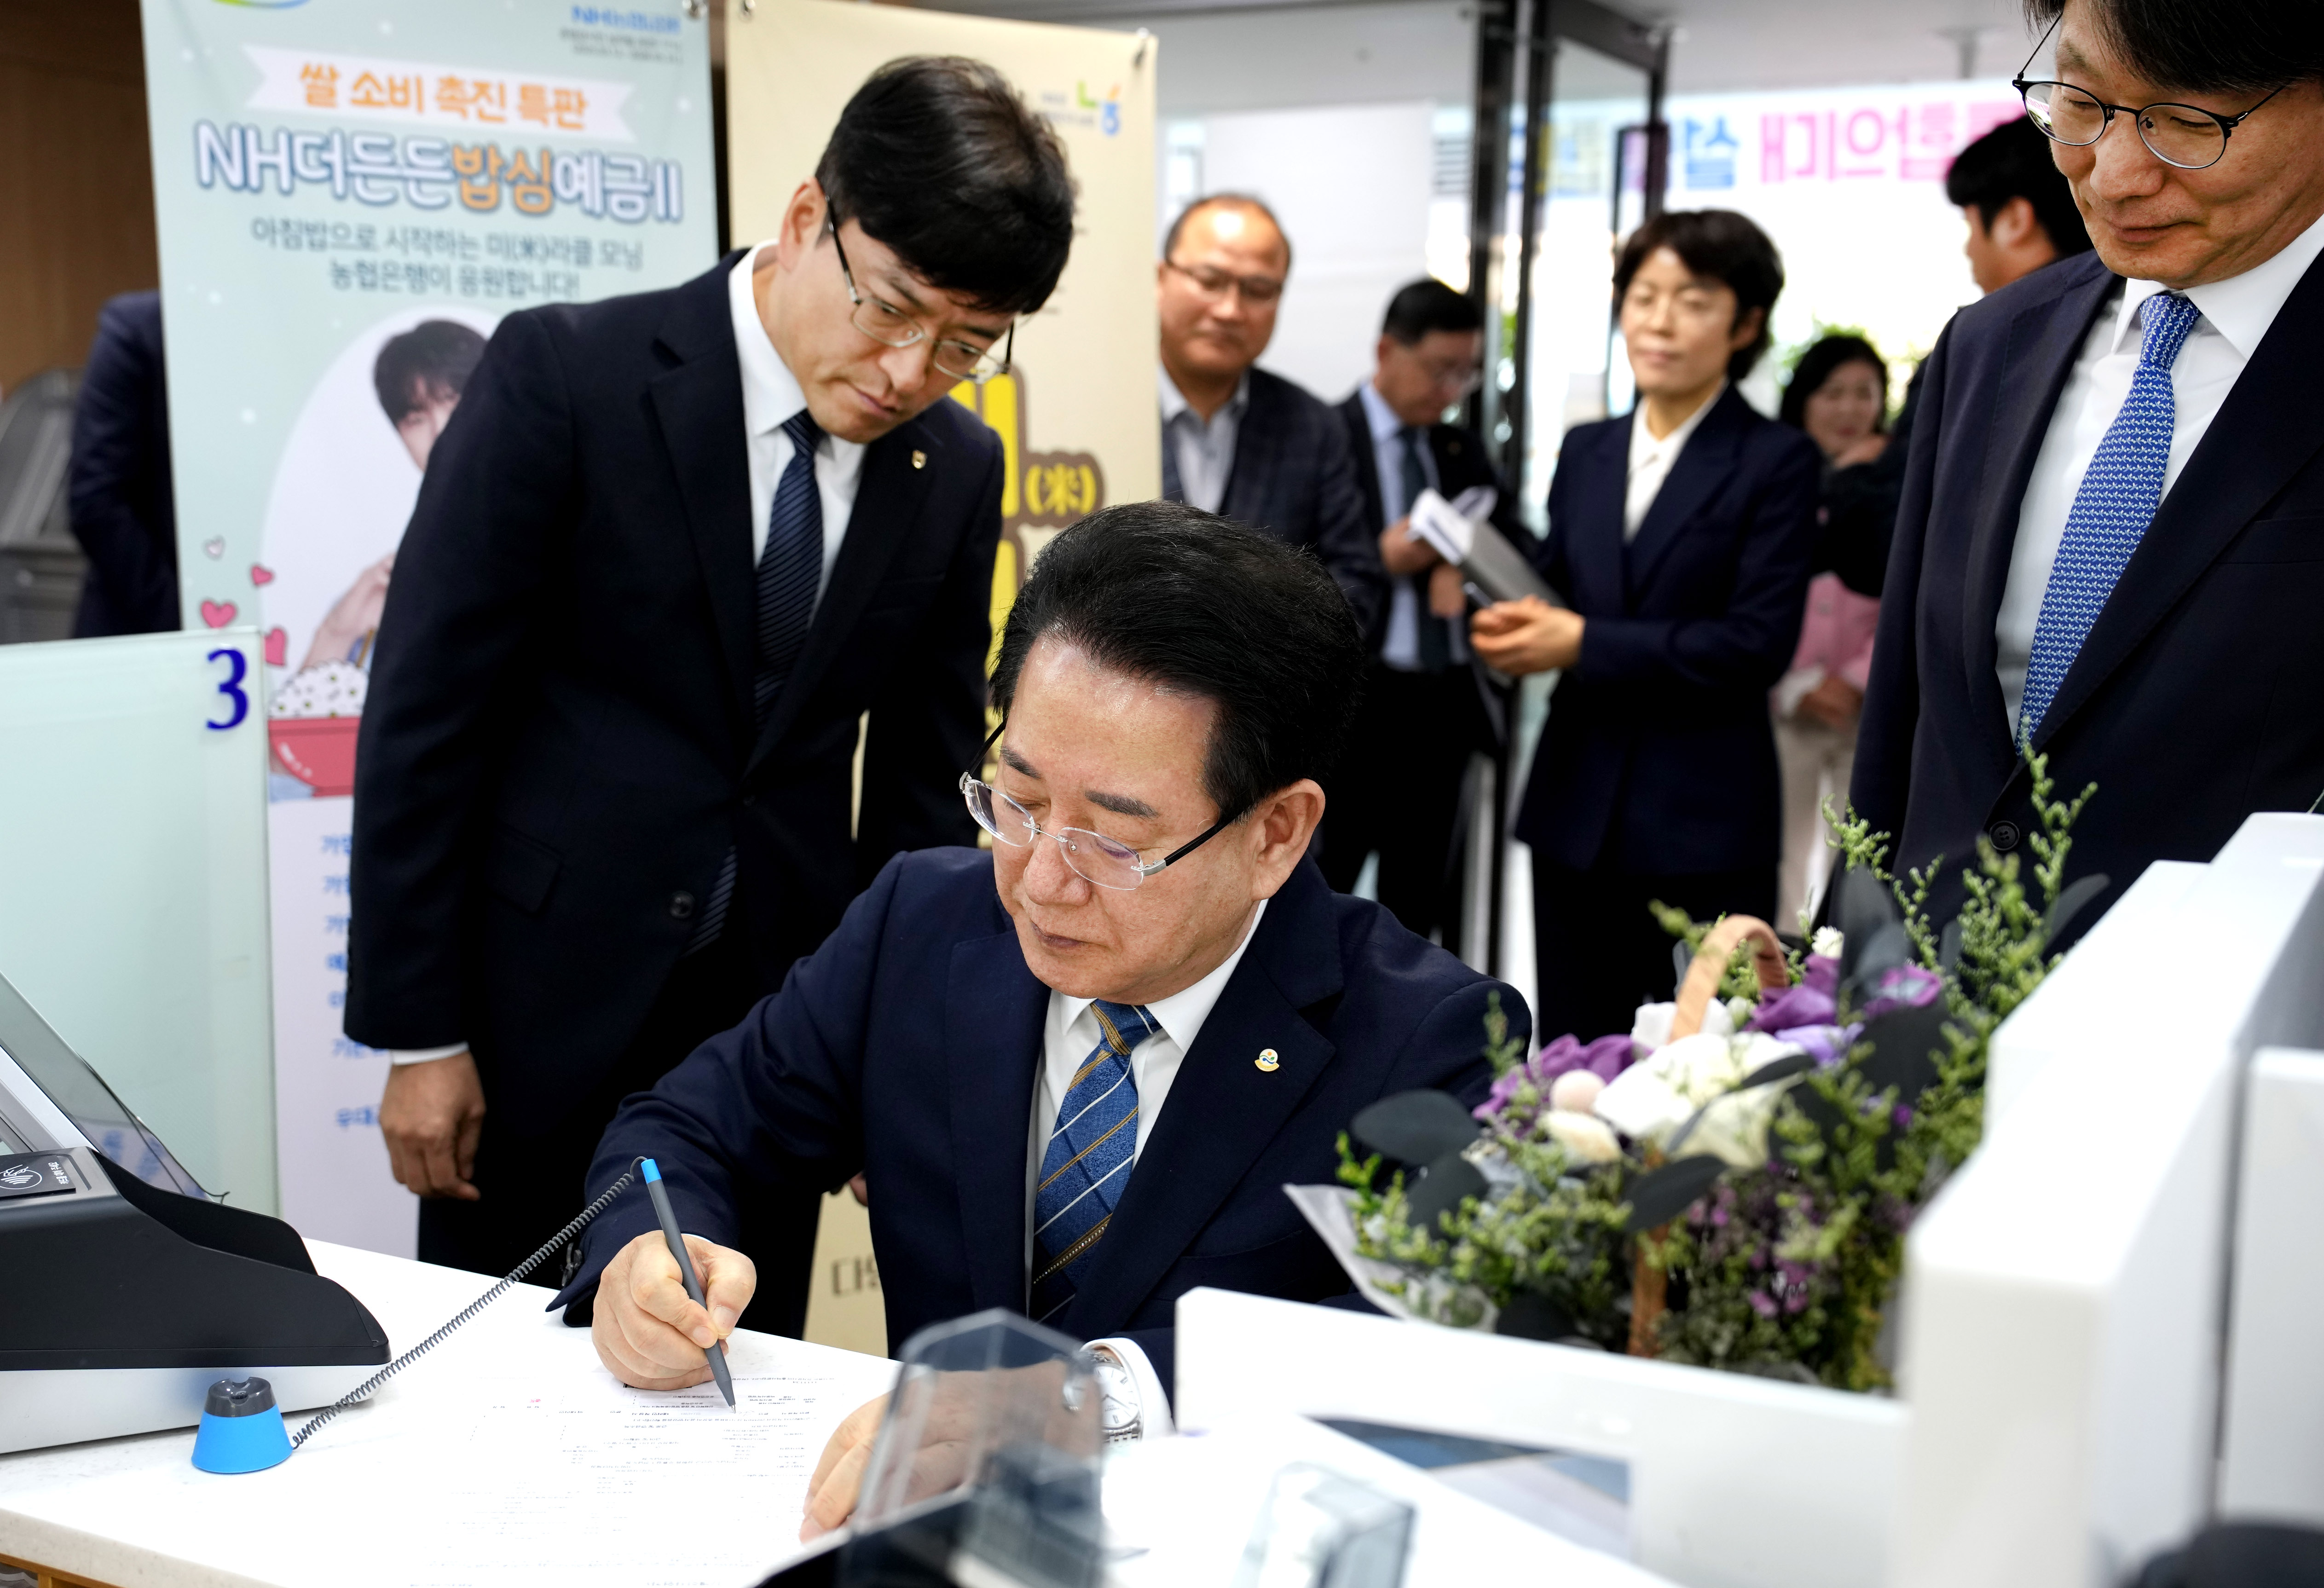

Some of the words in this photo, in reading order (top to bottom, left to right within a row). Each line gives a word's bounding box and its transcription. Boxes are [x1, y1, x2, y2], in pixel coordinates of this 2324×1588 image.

[300, 64, 340, 109] 쌀
[351, 70, 424, 115] 소비
[435, 75, 506, 122] 촉진
[518, 84, 588, 129] 특판
[251, 216, 378, 252] 아침밥으로
[386, 226, 480, 261] 시작하는
[599, 241, 644, 272] 모닝
[330, 257, 452, 295] 농협은행이
[207, 649, 249, 730] 3
[48, 1161, 62, 1170] 주세요
